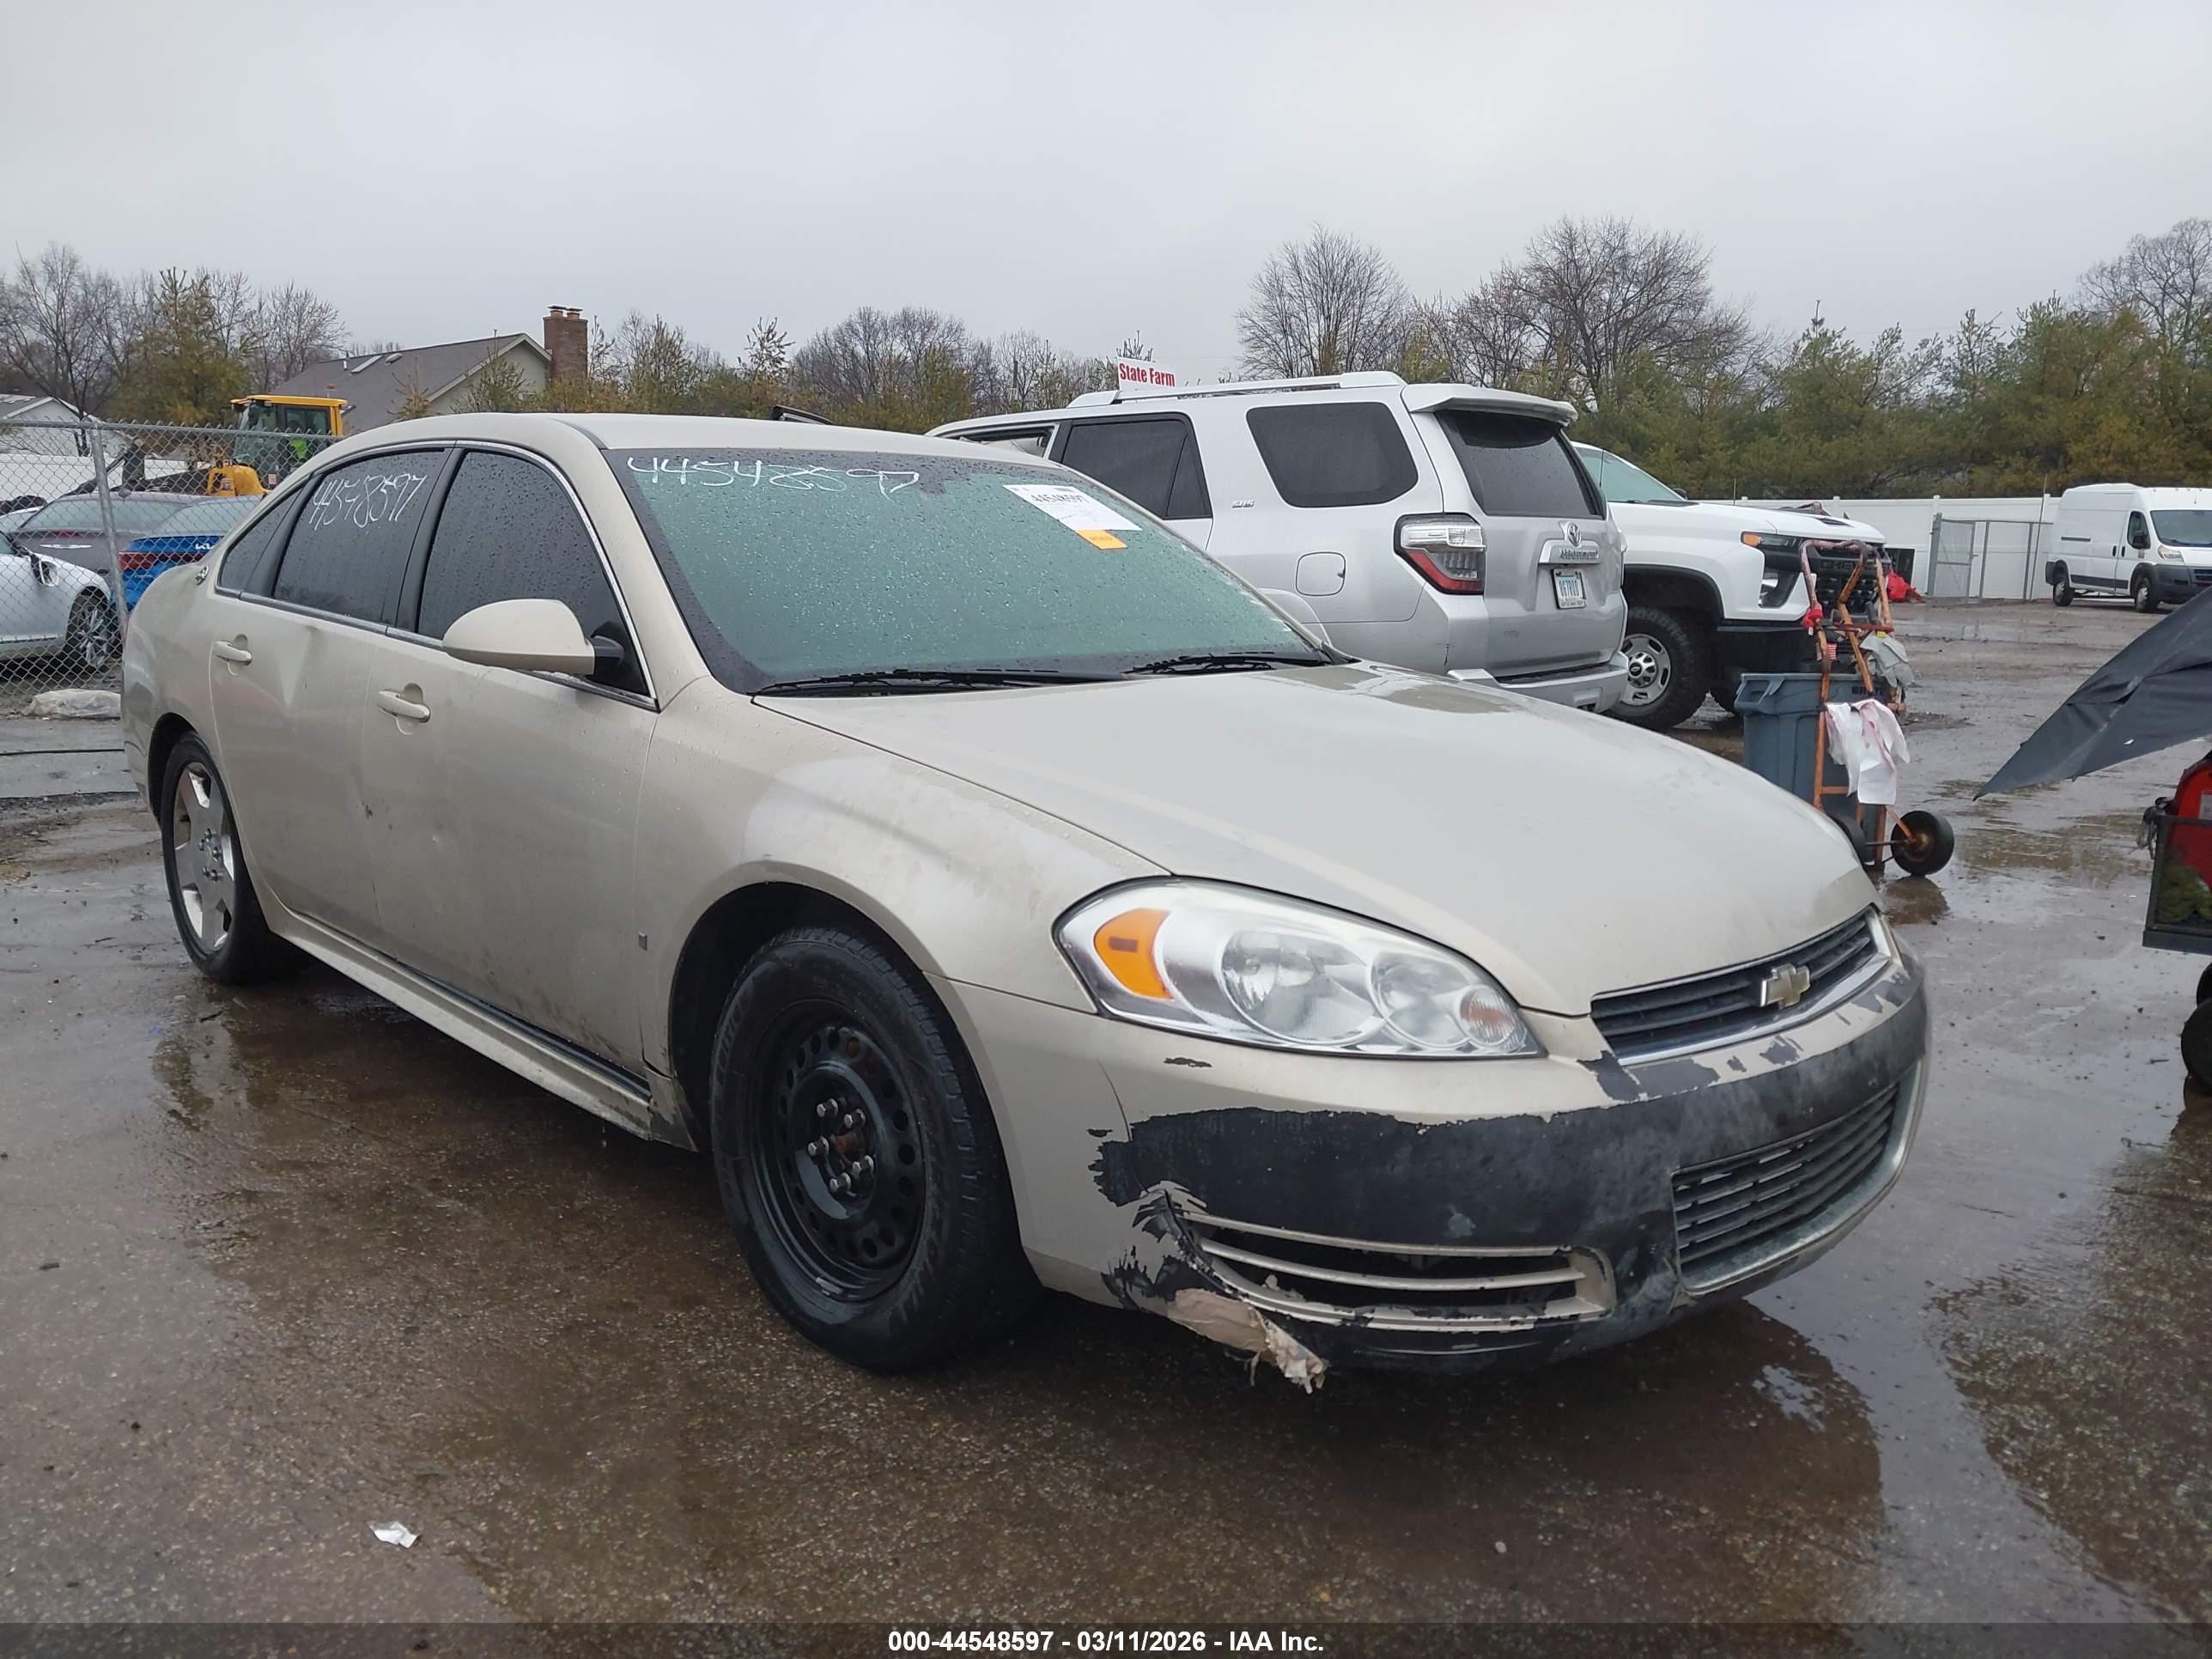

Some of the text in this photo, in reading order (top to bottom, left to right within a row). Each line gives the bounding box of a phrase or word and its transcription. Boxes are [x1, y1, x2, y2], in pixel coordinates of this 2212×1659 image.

[1118, 362, 1176, 388] State Farm
[627, 456, 921, 504] 44548597
